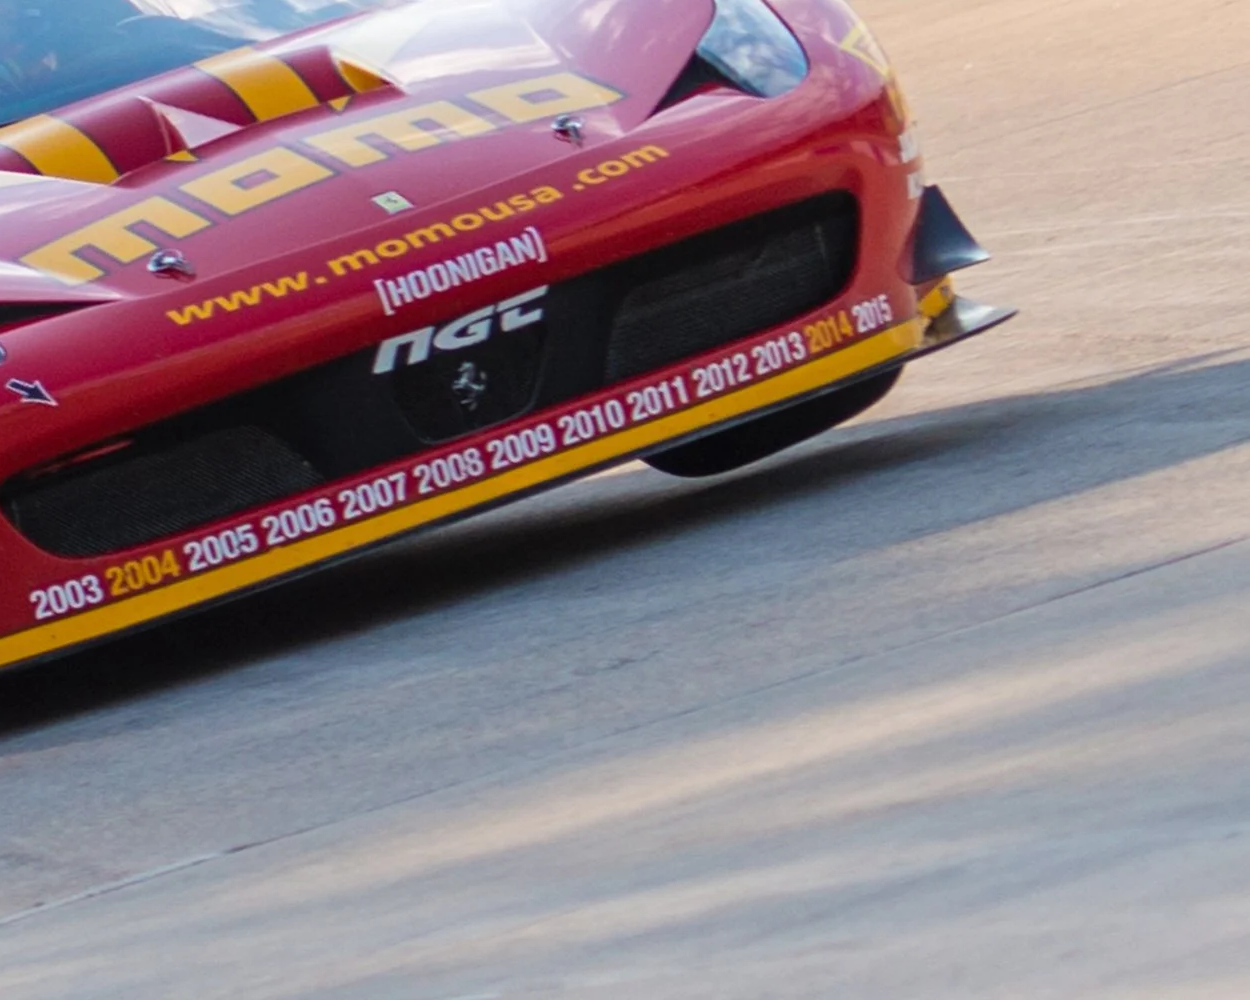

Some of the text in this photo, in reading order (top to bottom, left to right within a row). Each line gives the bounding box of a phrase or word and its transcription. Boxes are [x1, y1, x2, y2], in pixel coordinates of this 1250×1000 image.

[29, 294, 893, 620] 2003 2004 2005 2006 2007 2008 2009 2010 2011 2012 2013 2014 2015
